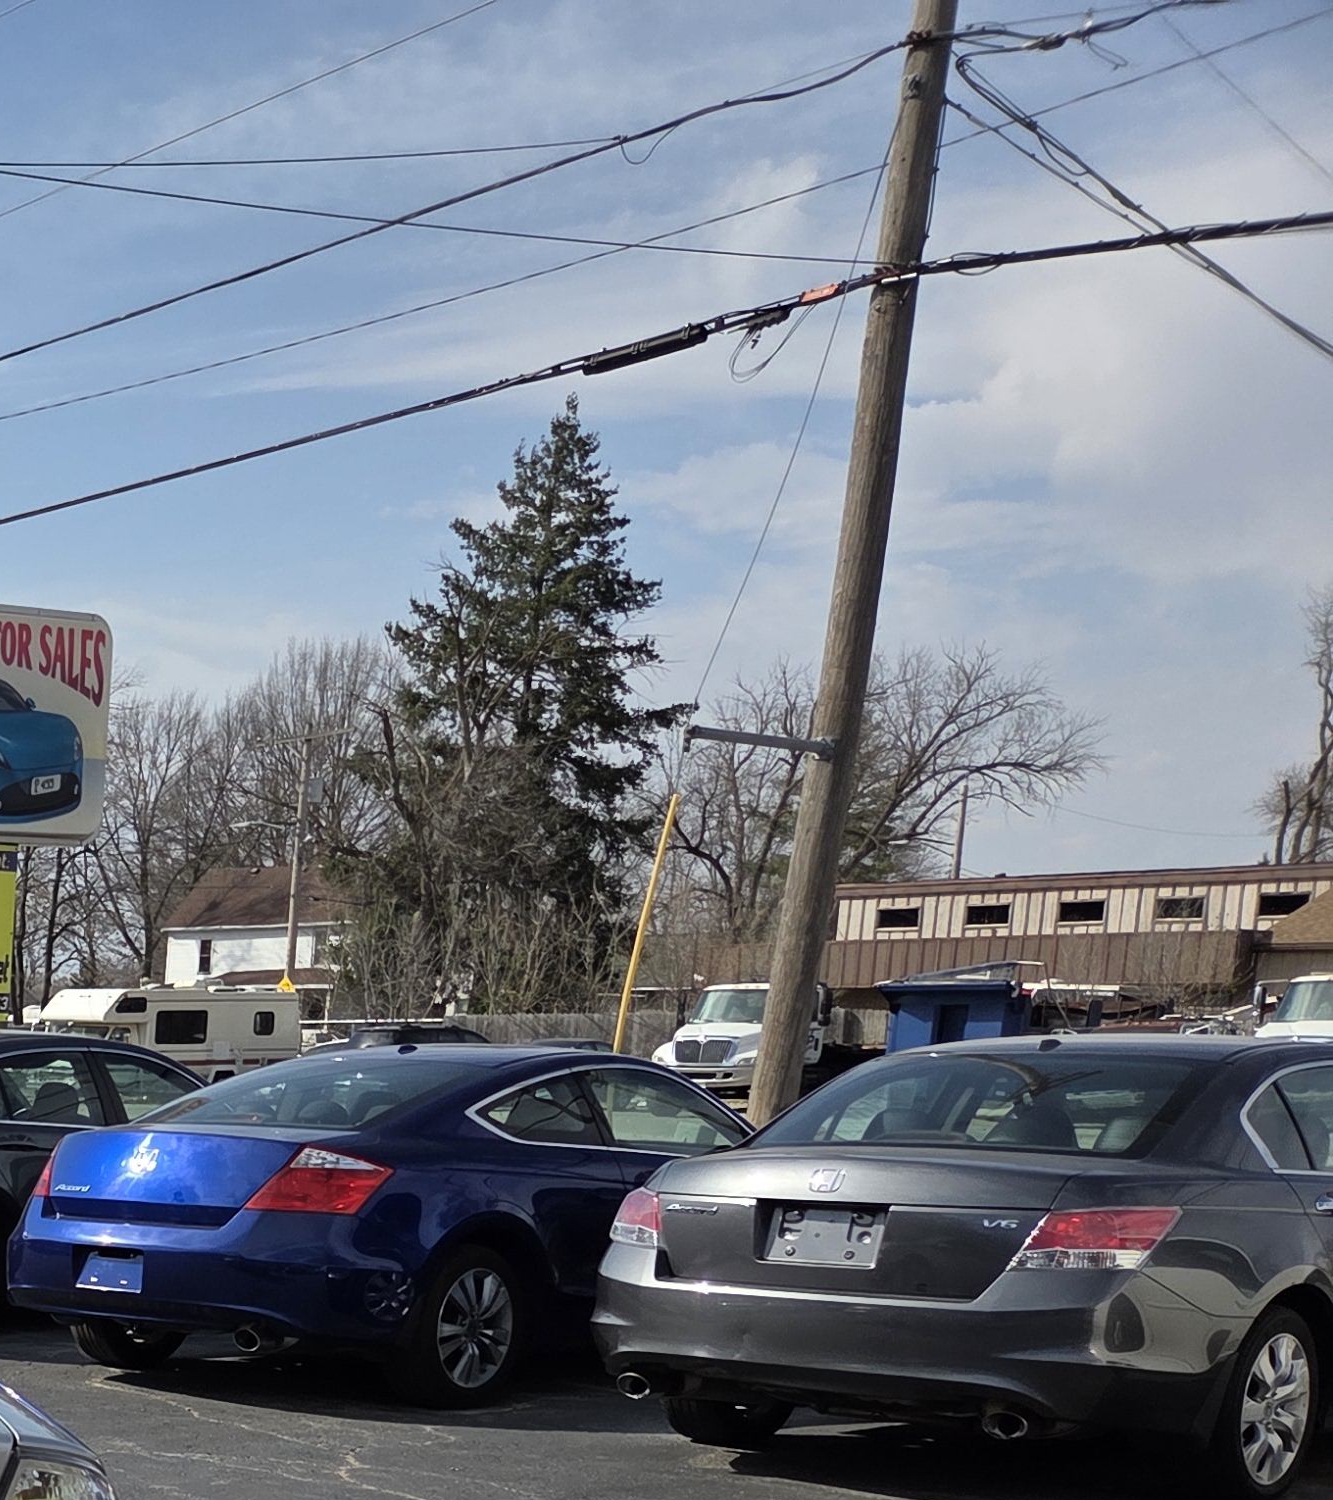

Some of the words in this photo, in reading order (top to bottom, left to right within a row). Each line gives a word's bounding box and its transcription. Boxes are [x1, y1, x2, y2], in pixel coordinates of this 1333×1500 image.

[39, 624, 106, 708] SALES
[54, 1183, 91, 1193] Accord
[983, 1219, 1020, 1229] V6
